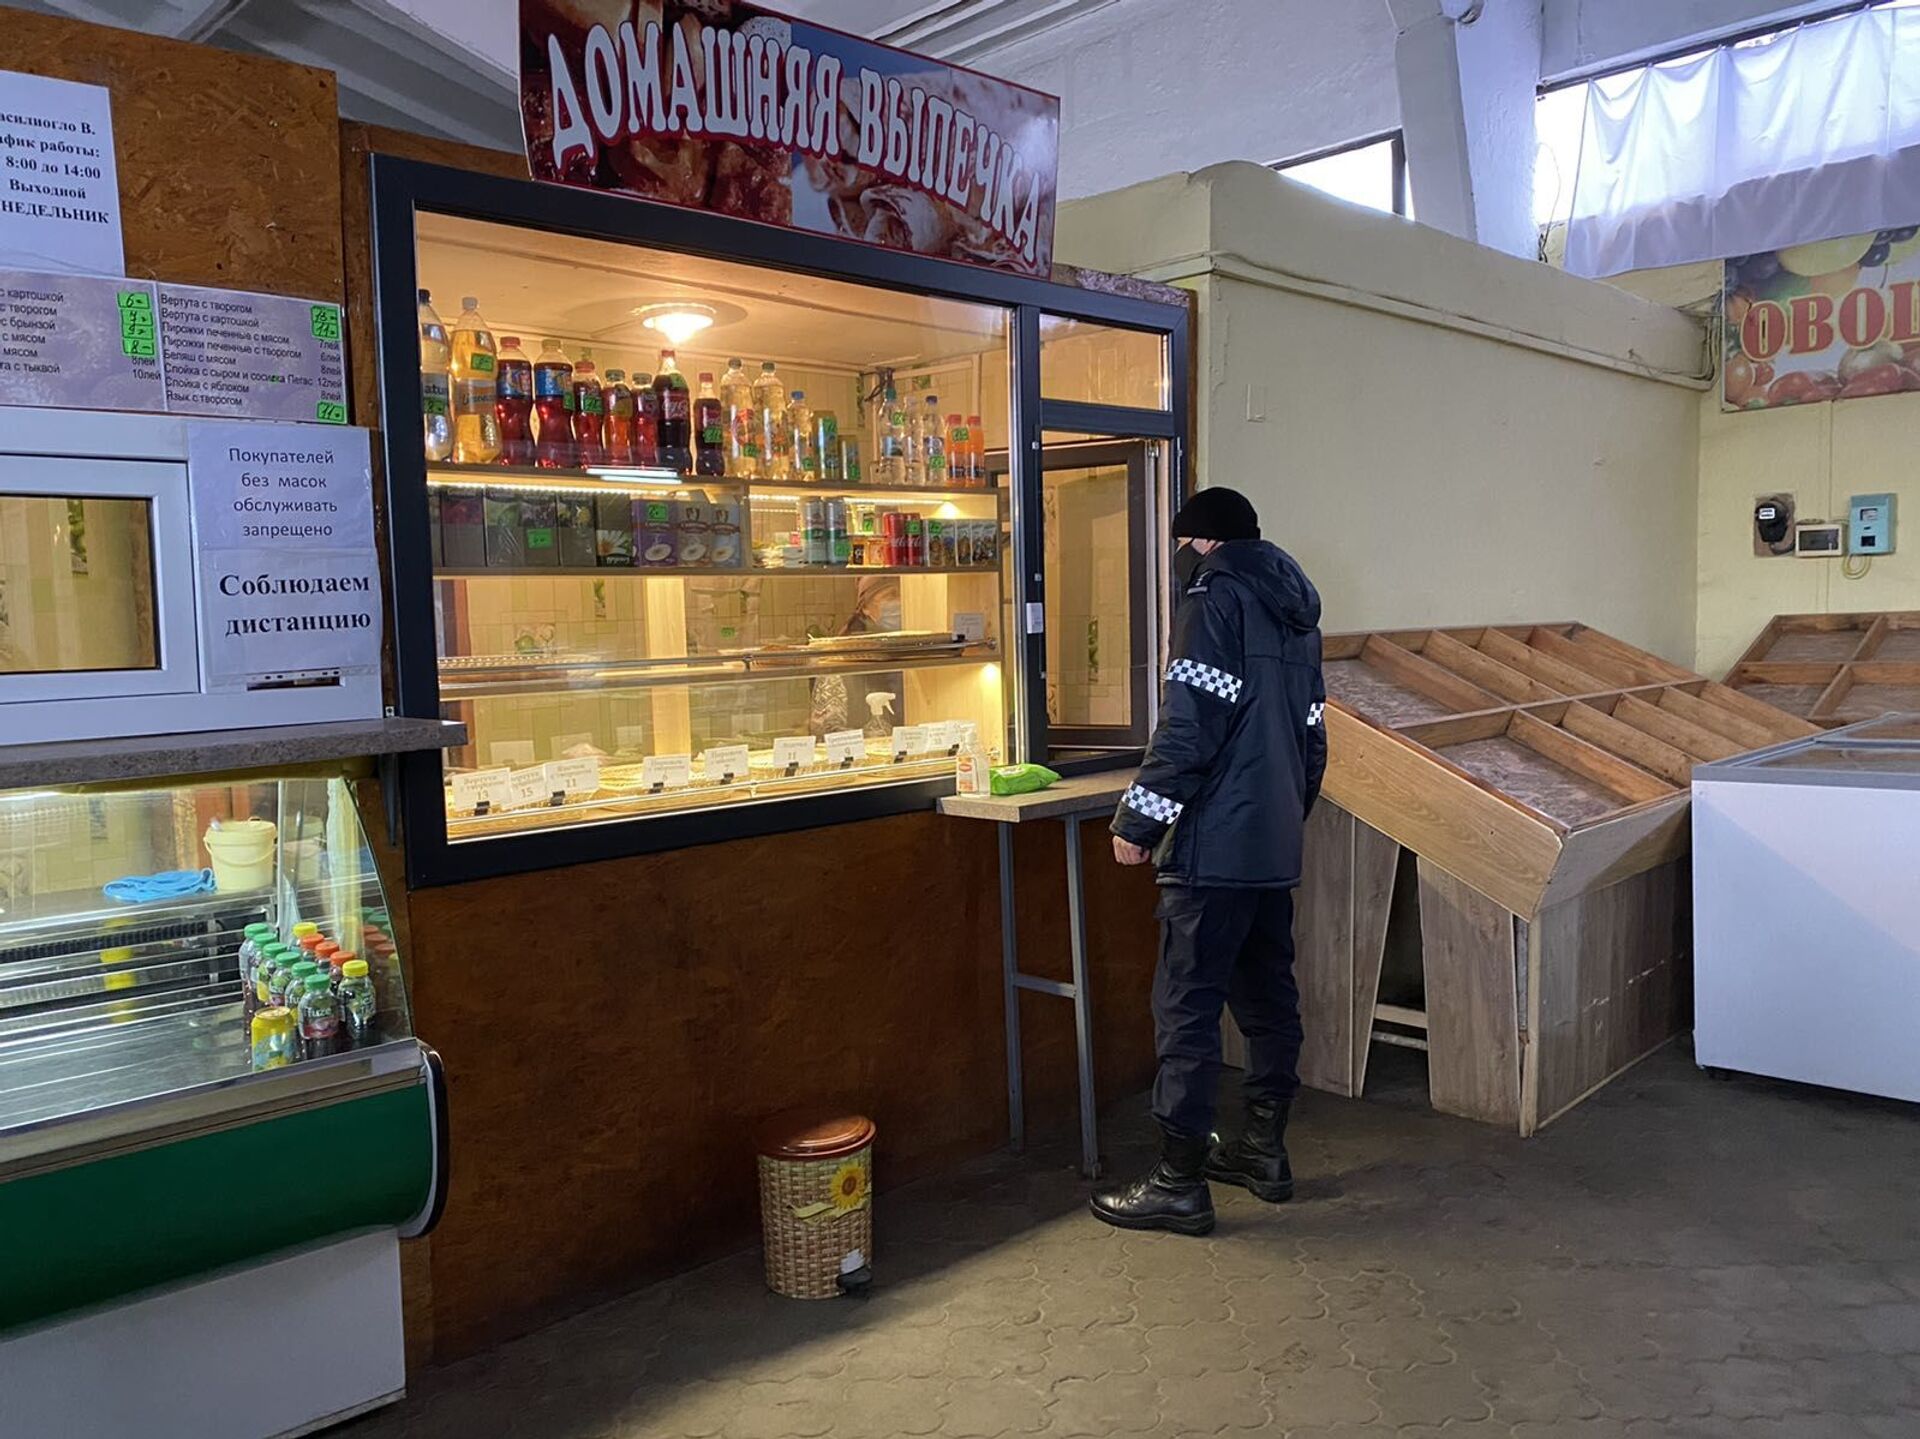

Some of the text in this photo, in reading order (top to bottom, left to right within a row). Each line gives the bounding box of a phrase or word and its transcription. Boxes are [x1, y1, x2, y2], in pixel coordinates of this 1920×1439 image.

[81, 122, 96, 135] В.
[548, 19, 1041, 263] ДОМАШНЯЯ ВЫПЕЧКА
[40, 140, 100, 158] работы:
[5, 155, 101, 179] 8:00 до 14:00
[10, 178, 86, 199] Выходной
[2, 200, 109, 224] НЕДЕЛЬНИК
[8, 289, 63, 302] картошкой
[10, 304, 57, 316] творогом
[160, 293, 252, 314] Вертута с творогом
[10, 316, 55, 331] брынзой
[162, 308, 259, 328] Вертута с картошкой
[2, 333, 46, 344] с мясом
[253, 333, 259, 341] с
[261, 335, 289, 344] мясом
[3, 347, 38, 358] мясом
[198, 355, 204, 363] с
[206, 355, 236, 365] мясом
[254, 347, 260, 355] с
[262, 347, 301, 359] творогом
[14, 363, 20, 371] с
[23, 363, 60, 374] тыквой
[202, 367, 208, 376] с
[210, 368, 240, 381] сыром
[242, 372, 249, 380] и
[202, 381, 208, 390] с
[192, 395, 198, 403] с
[200, 395, 243, 406] творогом
[229, 448, 334, 465] Покупателей
[241, 472, 327, 488] без масок
[233, 497, 338, 514] обслуживать
[243, 524, 333, 539] запрещено
[219, 574, 370, 597] Соблюдаем
[225, 612, 371, 636] дистанцию
[521, 787, 534, 798] 15
